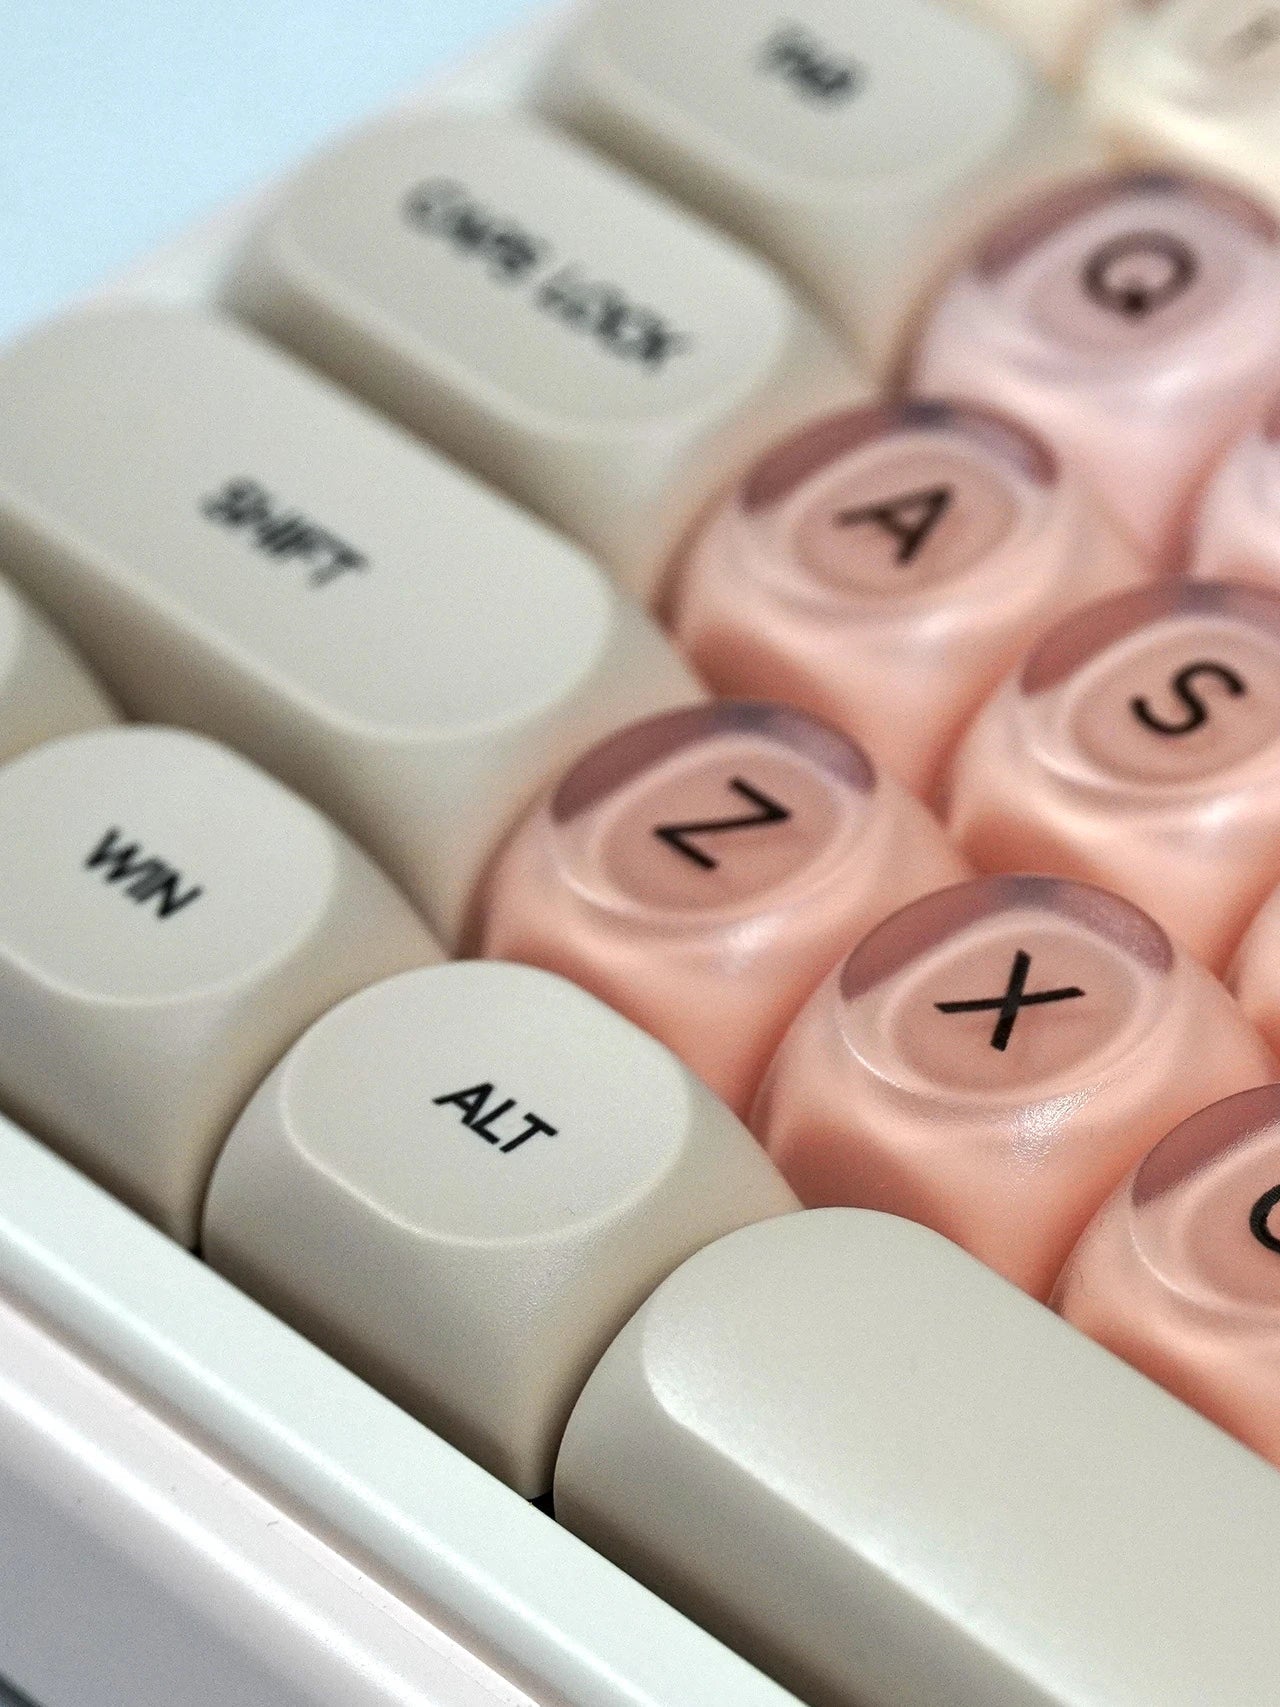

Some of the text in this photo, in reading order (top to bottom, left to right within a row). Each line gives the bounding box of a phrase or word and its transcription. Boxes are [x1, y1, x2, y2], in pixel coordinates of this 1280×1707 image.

[1080, 231, 1200, 323] Q
[201, 480, 367, 586] SHIFT
[834, 485, 952, 565] A
[1130, 662, 1246, 738] S
[654, 778, 791, 871] Z
[84, 827, 203, 920] WIN
[935, 950, 1085, 1051] X
[433, 1083, 557, 1153] ALT
